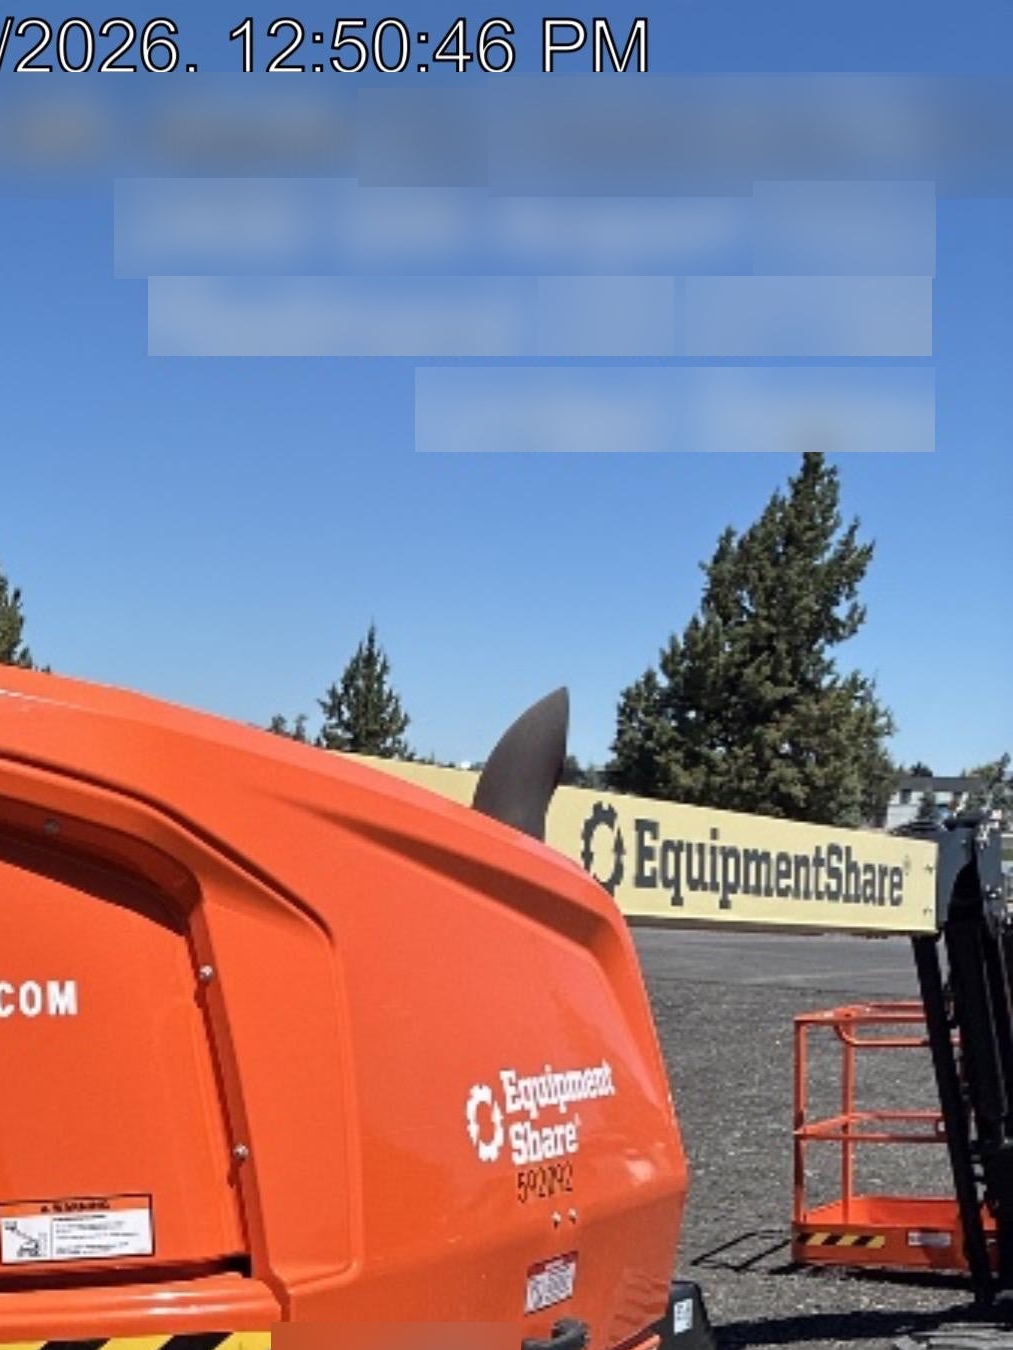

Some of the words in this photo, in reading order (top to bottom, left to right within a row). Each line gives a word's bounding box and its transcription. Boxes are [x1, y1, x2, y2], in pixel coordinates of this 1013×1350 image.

[634, 818, 904, 909] EquipmentShare
[499, 1059, 615, 1119] Equipment
[508, 1120, 580, 1165] Share
[516, 1161, 574, 1203] 592092
